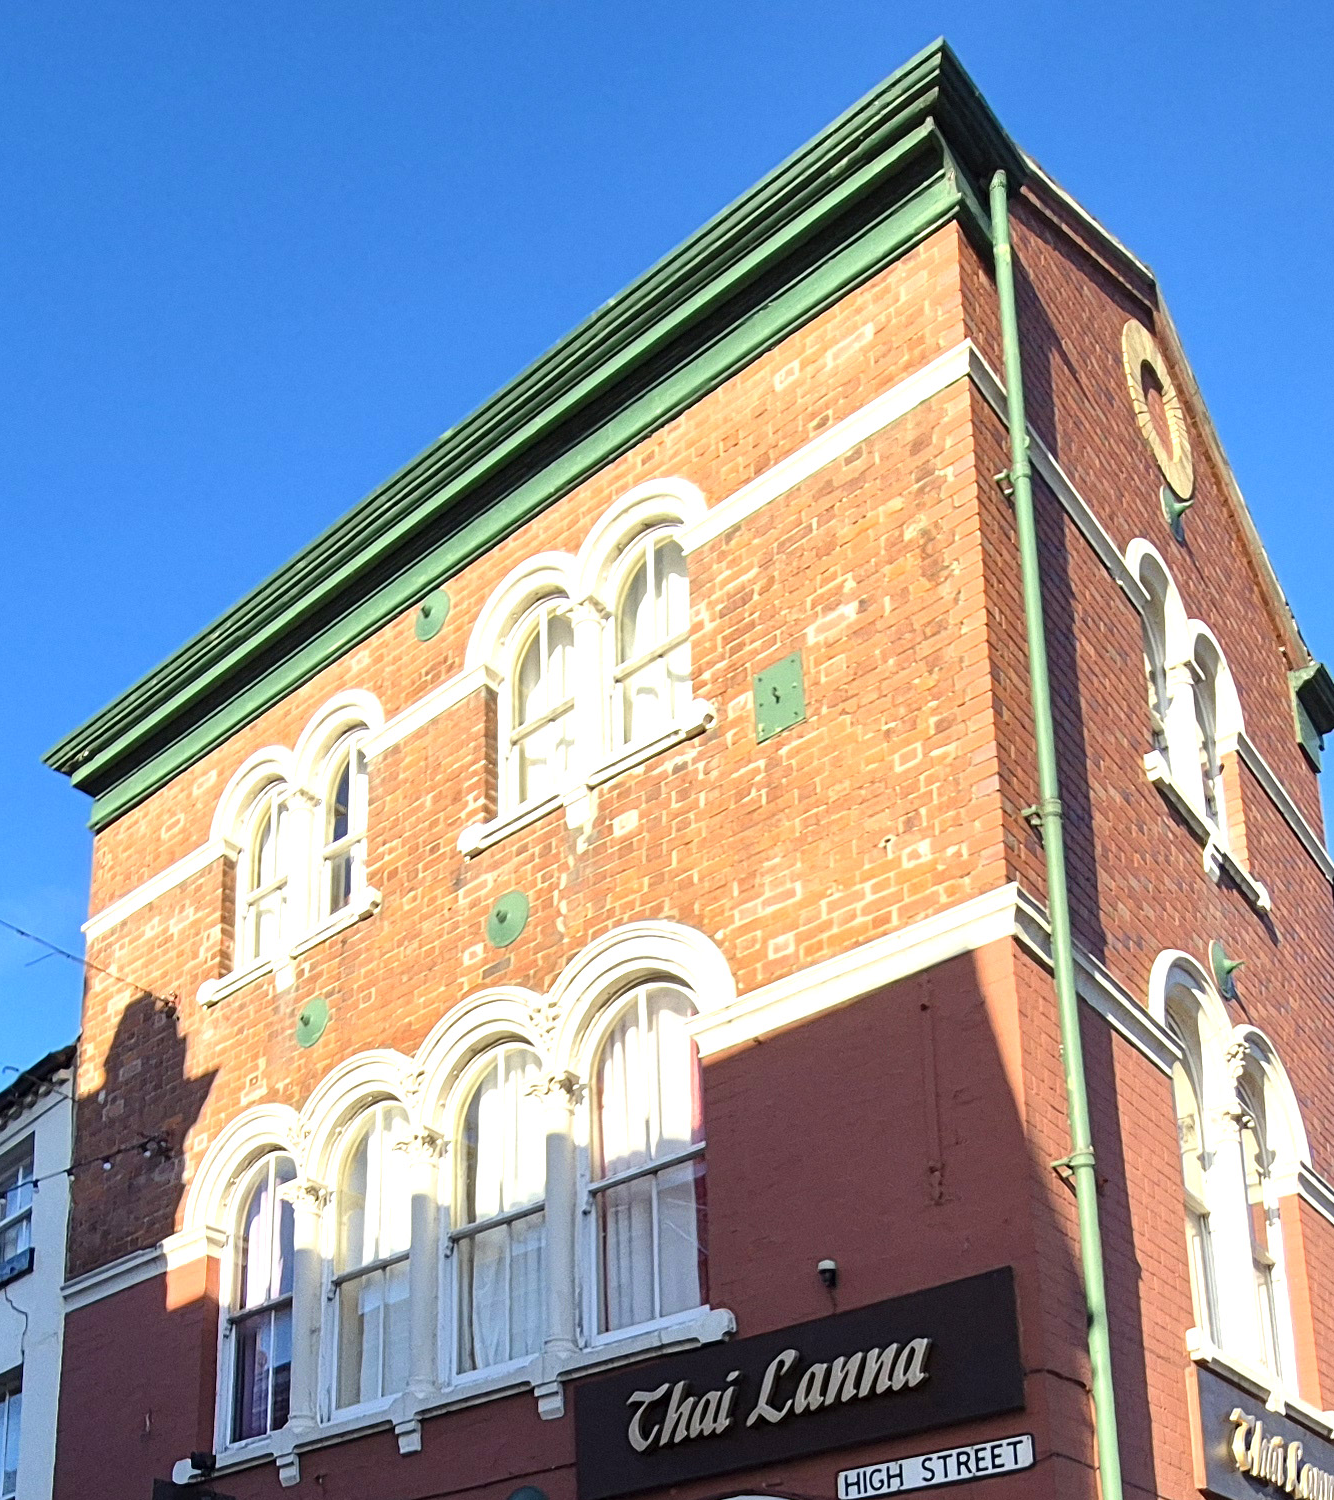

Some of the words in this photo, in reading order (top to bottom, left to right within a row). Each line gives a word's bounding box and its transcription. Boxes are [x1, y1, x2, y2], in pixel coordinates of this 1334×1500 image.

[627, 1370, 741, 1453] Thai
[746, 1337, 932, 1427] Lanna
[844, 1462, 904, 1497] HIGH
[921, 1440, 1024, 1483] STREET
[1229, 1407, 1284, 1486] Thai
